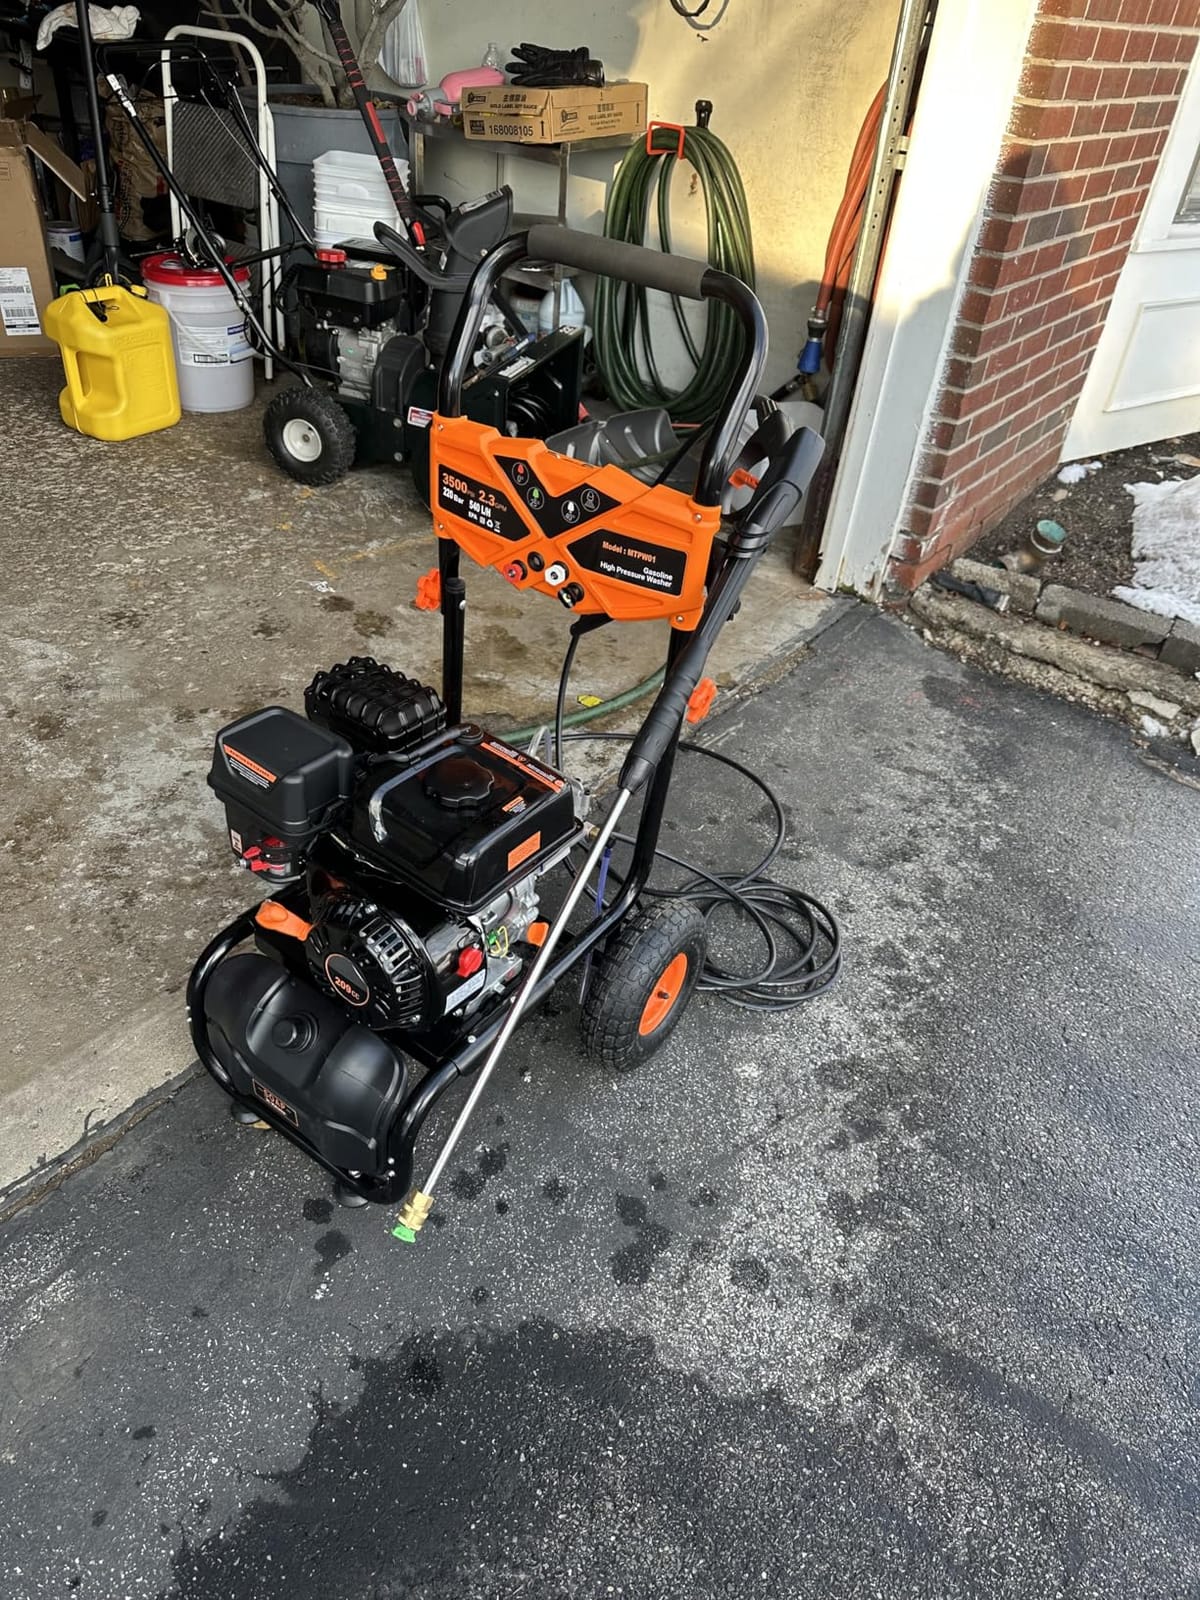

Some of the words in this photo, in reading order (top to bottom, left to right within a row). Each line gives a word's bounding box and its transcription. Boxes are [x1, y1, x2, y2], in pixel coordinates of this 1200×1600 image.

[489, 125, 534, 137] 168008105
[442, 473, 468, 494] 3500
[479, 490, 495, 506] 2.3
[443, 486, 454, 499] 220
[602, 541, 623, 554] Model
[627, 548, 656, 563] MTPW01
[600, 561, 616, 572] High
[616, 566, 646, 581] Pressure
[646, 575, 672, 588] Washer
[643, 567, 673, 581] Gasoline
